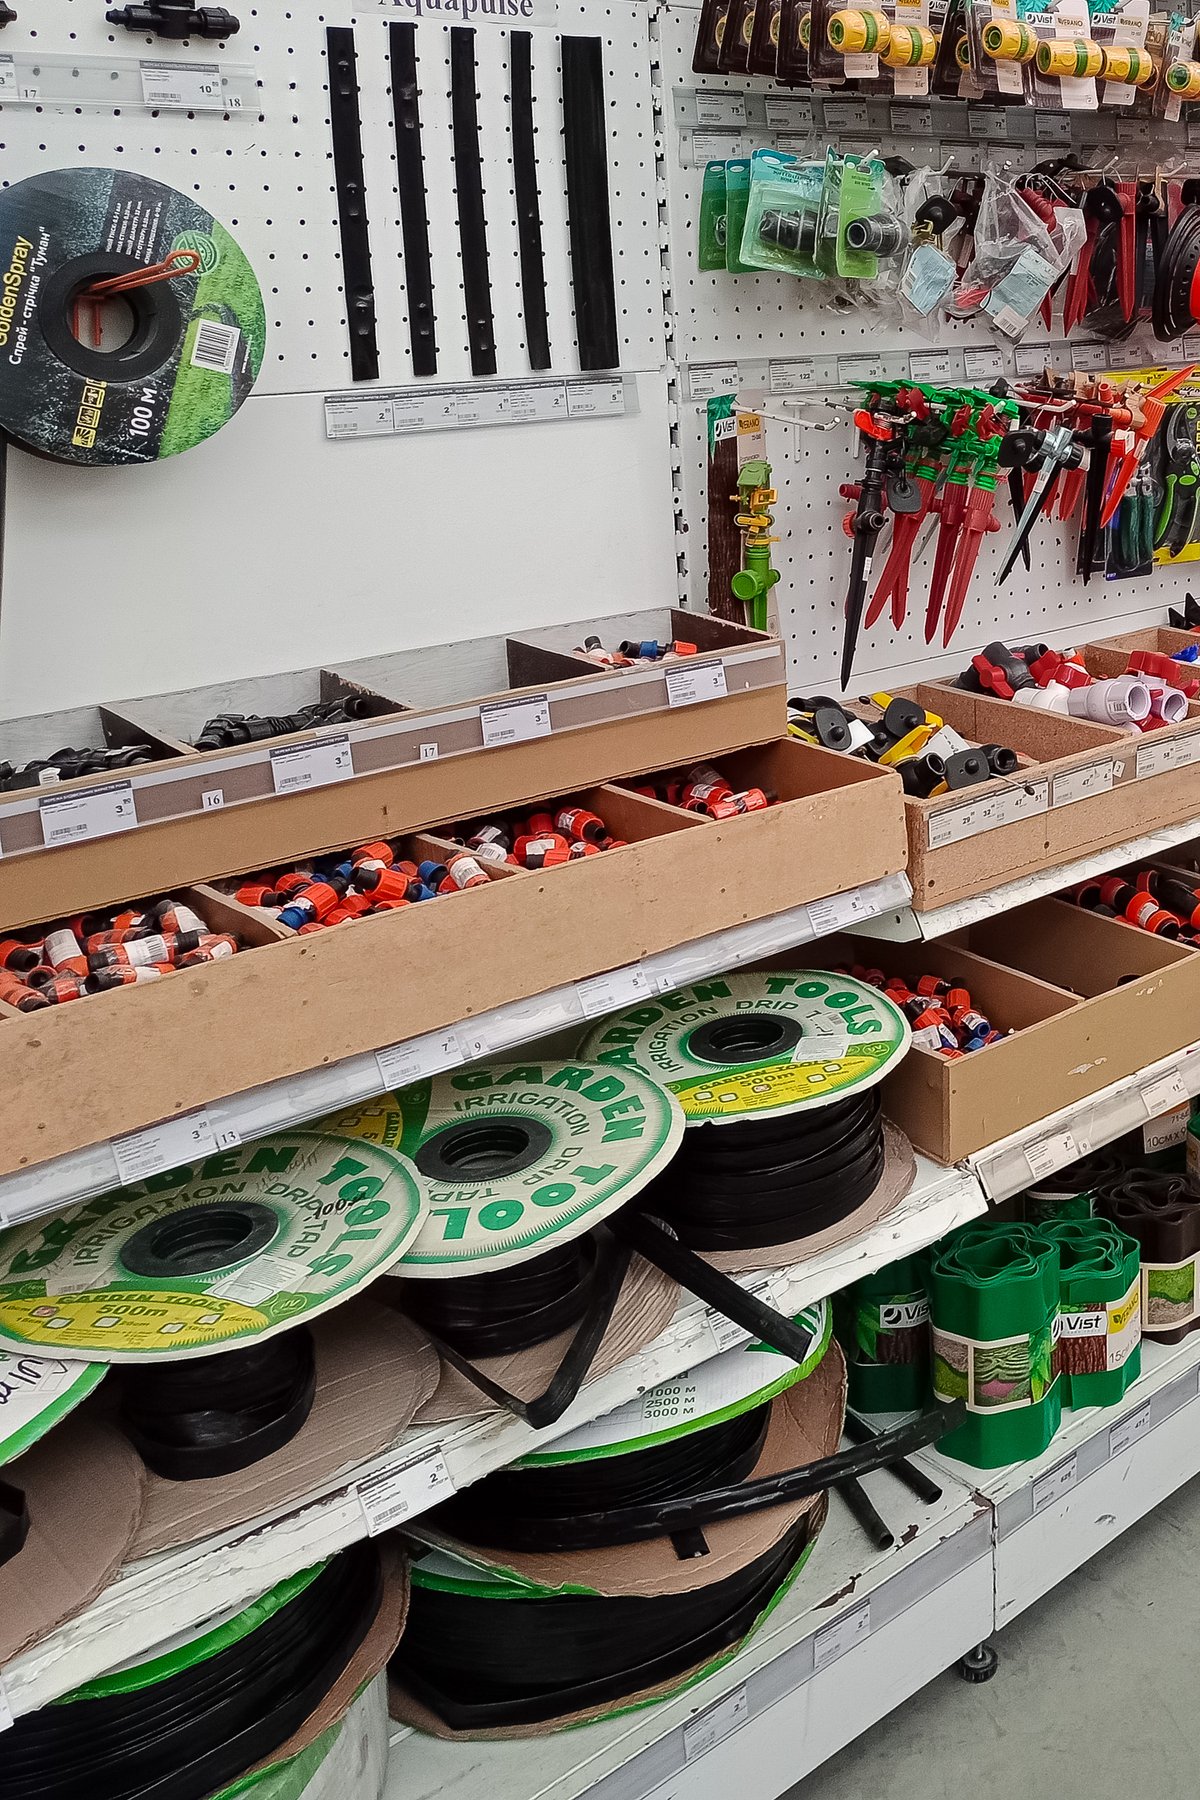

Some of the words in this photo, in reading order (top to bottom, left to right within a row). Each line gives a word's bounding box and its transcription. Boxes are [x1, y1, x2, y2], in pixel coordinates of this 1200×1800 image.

[1036, 14, 1052, 24] Vist
[1102, 14, 1116, 24] Vist
[24, 89, 37, 98] 17
[200, 86, 212, 94] 10
[229, 98, 241, 107] 18
[9, 325, 28, 365] Спрей
[23, 274, 41, 320] стрічка
[129, 403, 151, 437] 100
[722, 419, 735, 432] Vist
[712, 677, 719, 685] 3
[423, 747, 434, 757] 17
[335, 757, 342, 765] 3
[207, 794, 220, 806] 16
[632, 978, 638, 986] 5
[663, 978, 669, 987] 4
[599, 980, 733, 1073] ARDEN
[765, 976, 883, 1038] TOOLS
[651, 1006, 720, 1073] IRRIGATION
[735, 998, 799, 1013] DRIP
[442, 1043, 448, 1052] 7
[474, 1042, 481, 1052] 9
[739, 1072, 795, 1087] 500m
[1173, 1083, 1180, 1092] 11
[451, 1064, 647, 1143] GARDEN
[454, 1091, 591, 1137] IRRIGATION
[192, 1131, 200, 1139] 3
[221, 1131, 236, 1143] 13
[1063, 1141, 1069, 1149] 7
[521, 1146, 582, 1187] DRIP
[431, 1163, 619, 1240] TOOL
[307, 1156, 390, 1277] TOOLS
[74, 1182, 248, 1267] IRRIGATION
[264, 1183, 324, 1212] DRIP
[55, 1294, 156, 1305] GARDEN
[160, 1294, 232, 1312] TOOLS
[97, 1304, 168, 1317] 500m
[905, 1303, 929, 1322] Vis
[1066, 1315, 1102, 1330] Vist
[647, 1387, 681, 1398] 1000
[646, 1397, 680, 1409] 2500
[644, 1407, 678, 1419] 3000
[430, 1473, 438, 1483] 2
